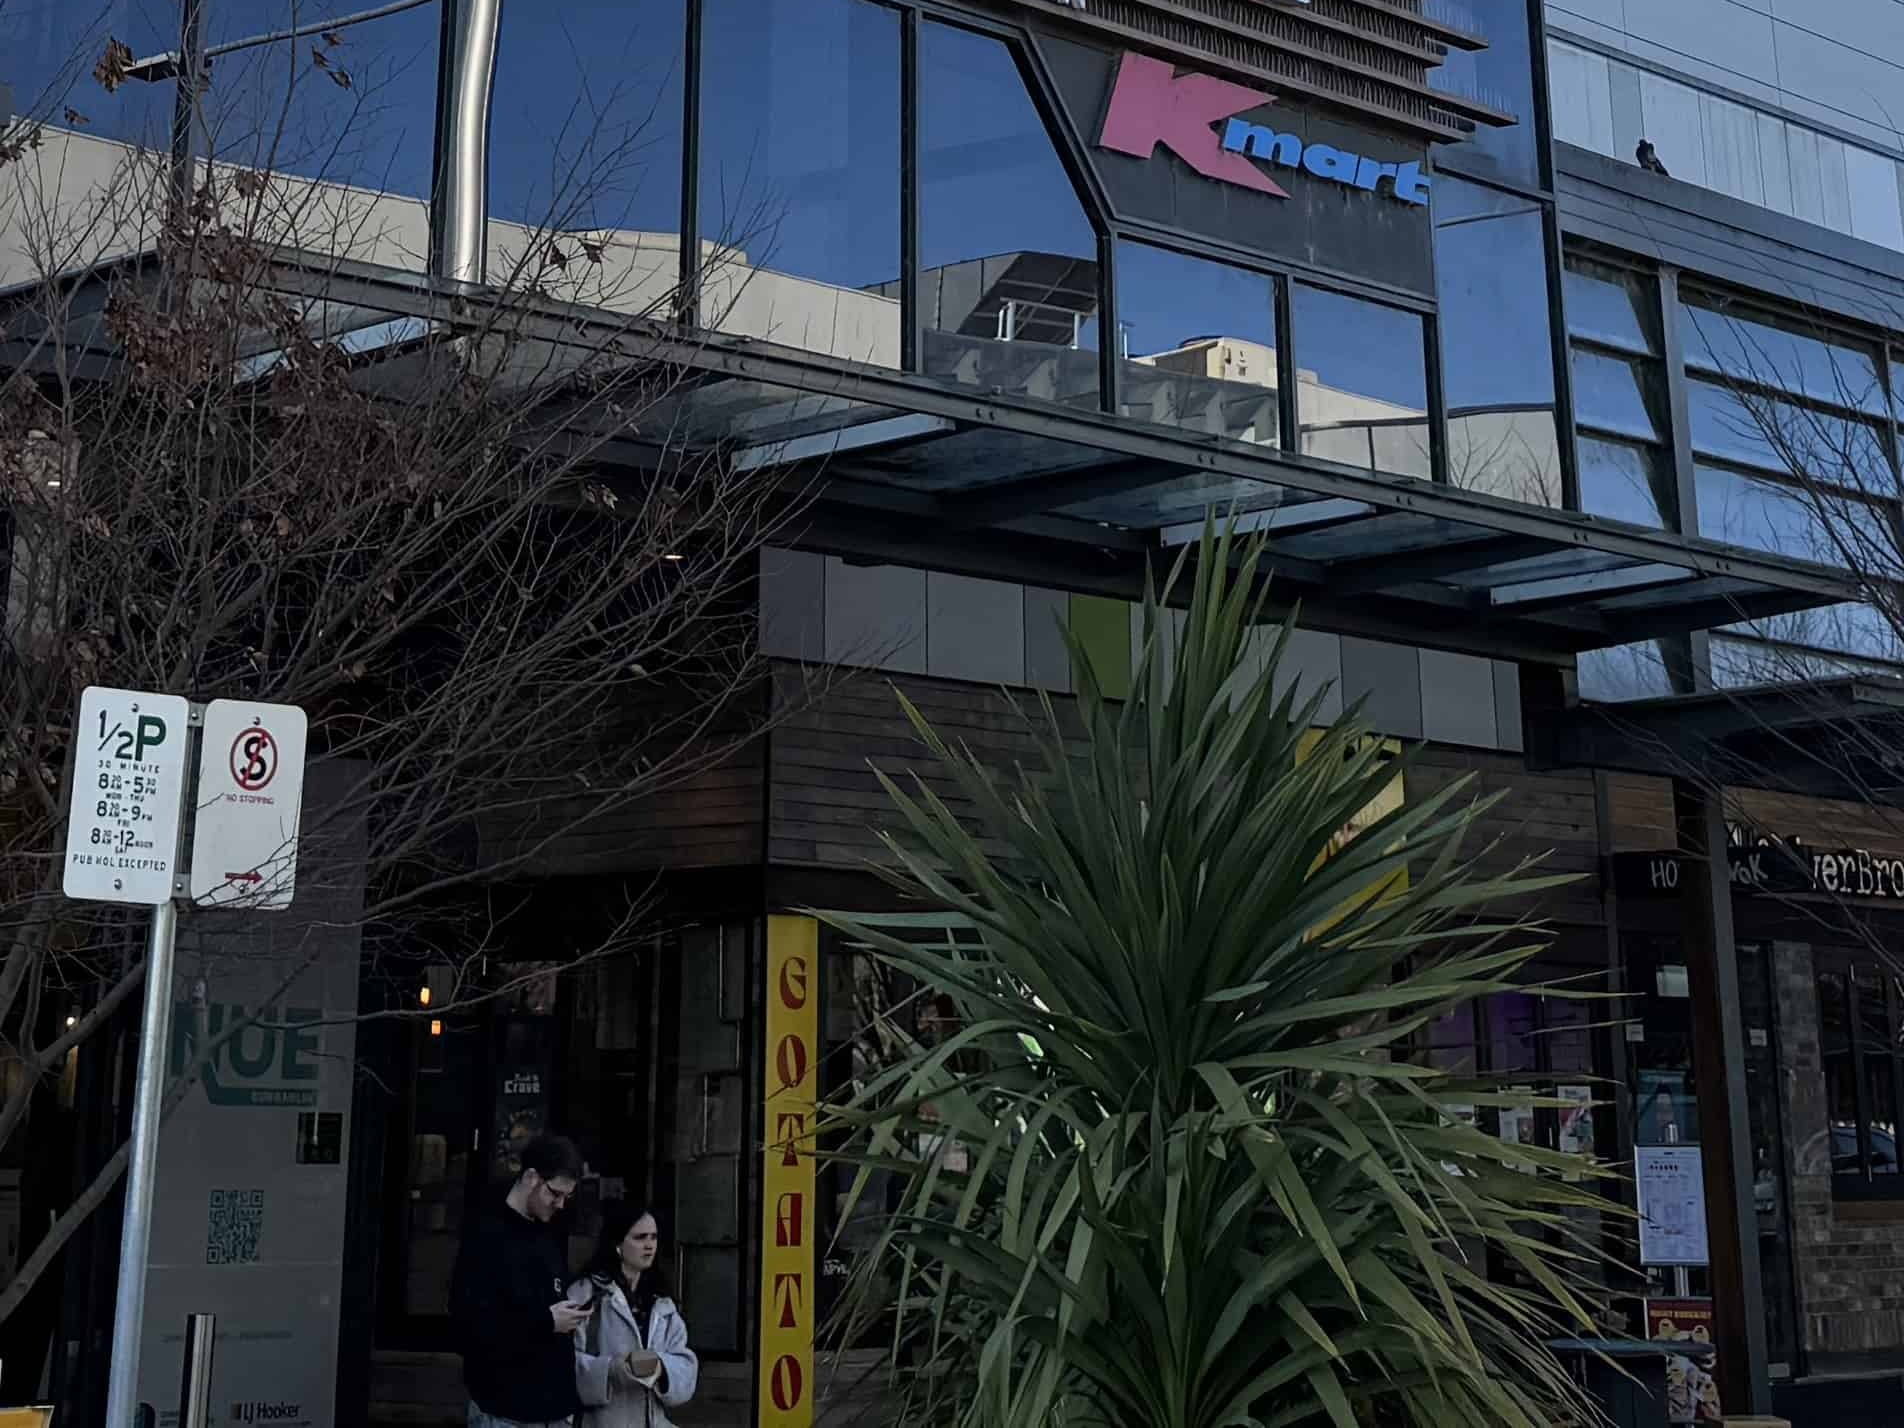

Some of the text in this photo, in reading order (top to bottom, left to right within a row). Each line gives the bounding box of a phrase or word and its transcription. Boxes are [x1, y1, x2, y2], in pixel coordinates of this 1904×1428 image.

[120, 761, 159, 774] MINUTE
[73, 853, 166, 872] PUB HOL EXCEPTED
[770, 956, 808, 1411] GOTATO
